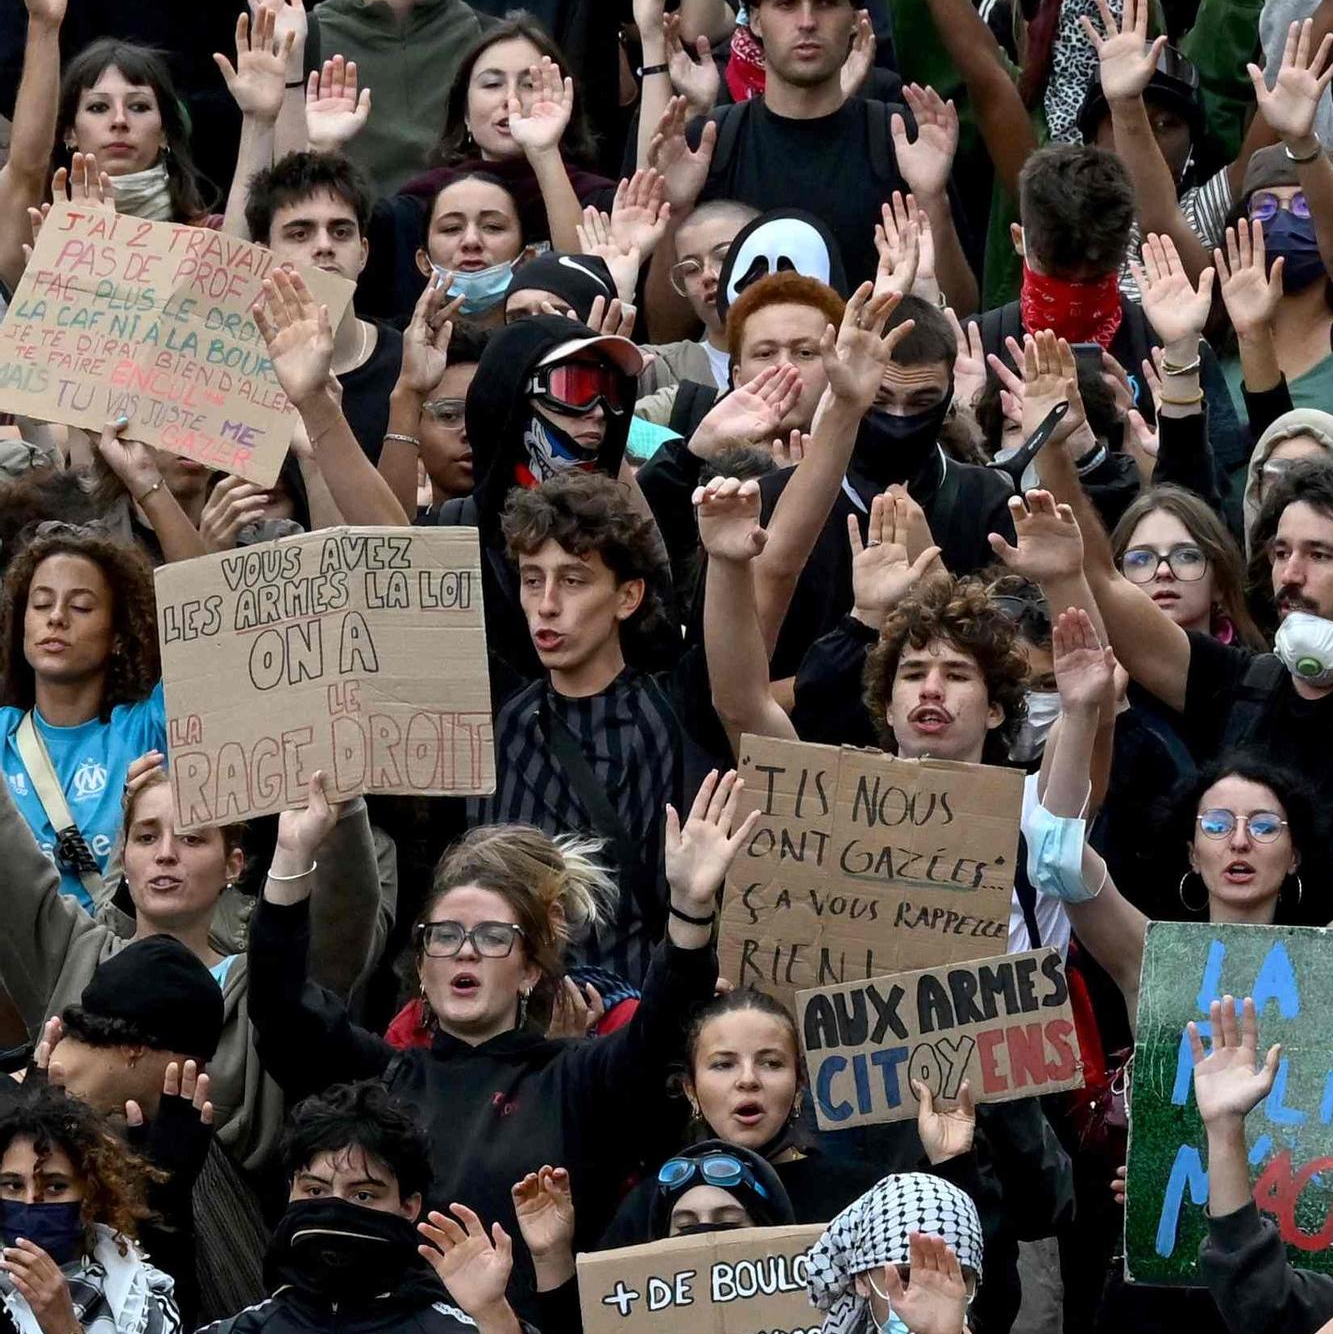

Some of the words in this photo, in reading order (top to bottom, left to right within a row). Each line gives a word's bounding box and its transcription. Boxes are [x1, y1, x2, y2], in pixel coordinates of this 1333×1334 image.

[58, 212, 118, 241] J'AI
[126, 222, 153, 248] 2
[32, 270, 79, 301] FAC
[93, 280, 155, 311] PLUS
[162, 291, 197, 322] LE
[55, 239, 117, 278] PAS
[123, 253, 162, 283] DE
[172, 258, 249, 303] PROF
[4, 323, 32, 342] JE
[41, 329, 66, 347] TE
[154, 351, 213, 385] BIEN
[15, 300, 47, 321] LA
[57, 305, 105, 331] CAF
[164, 328, 199, 354] LA
[16, 345, 37, 359] TE
[47, 351, 106, 376] FAIRE
[57, 379, 96, 411] TU
[105, 389, 139, 416] VAS
[142, 398, 207, 430] JUSTE
[220, 420, 265, 447] ME
[159, 424, 255, 471] GAZER
[221, 546, 302, 591] VOUS
[320, 537, 412, 575] AVEZ
[163, 595, 223, 645] LES
[234, 571, 350, 631] ARMES
[365, 571, 409, 609] LA
[419, 571, 471, 609] LOI
[249, 618, 323, 690] ON
[339, 611, 379, 674] A
[327, 679, 361, 715] LE
[170, 714, 202, 748] LA
[174, 725, 314, 828] RAGE
[331, 711, 494, 793] DROIT
[852, 775, 954, 827] NOUS
[746, 828, 830, 866] ONT
[743, 883, 791, 924] ÇA
[810, 889, 879, 920] VOUS
[894, 902, 1007, 938] RAPPELLE
[739, 939, 845, 985] RIEN
[1195, 939, 1299, 1019] LA
[804, 984, 909, 1051] AUX
[917, 955, 1067, 1035] ARMES
[816, 1019, 1075, 1122] CITOYENS
[647, 1270, 697, 1312] DE
